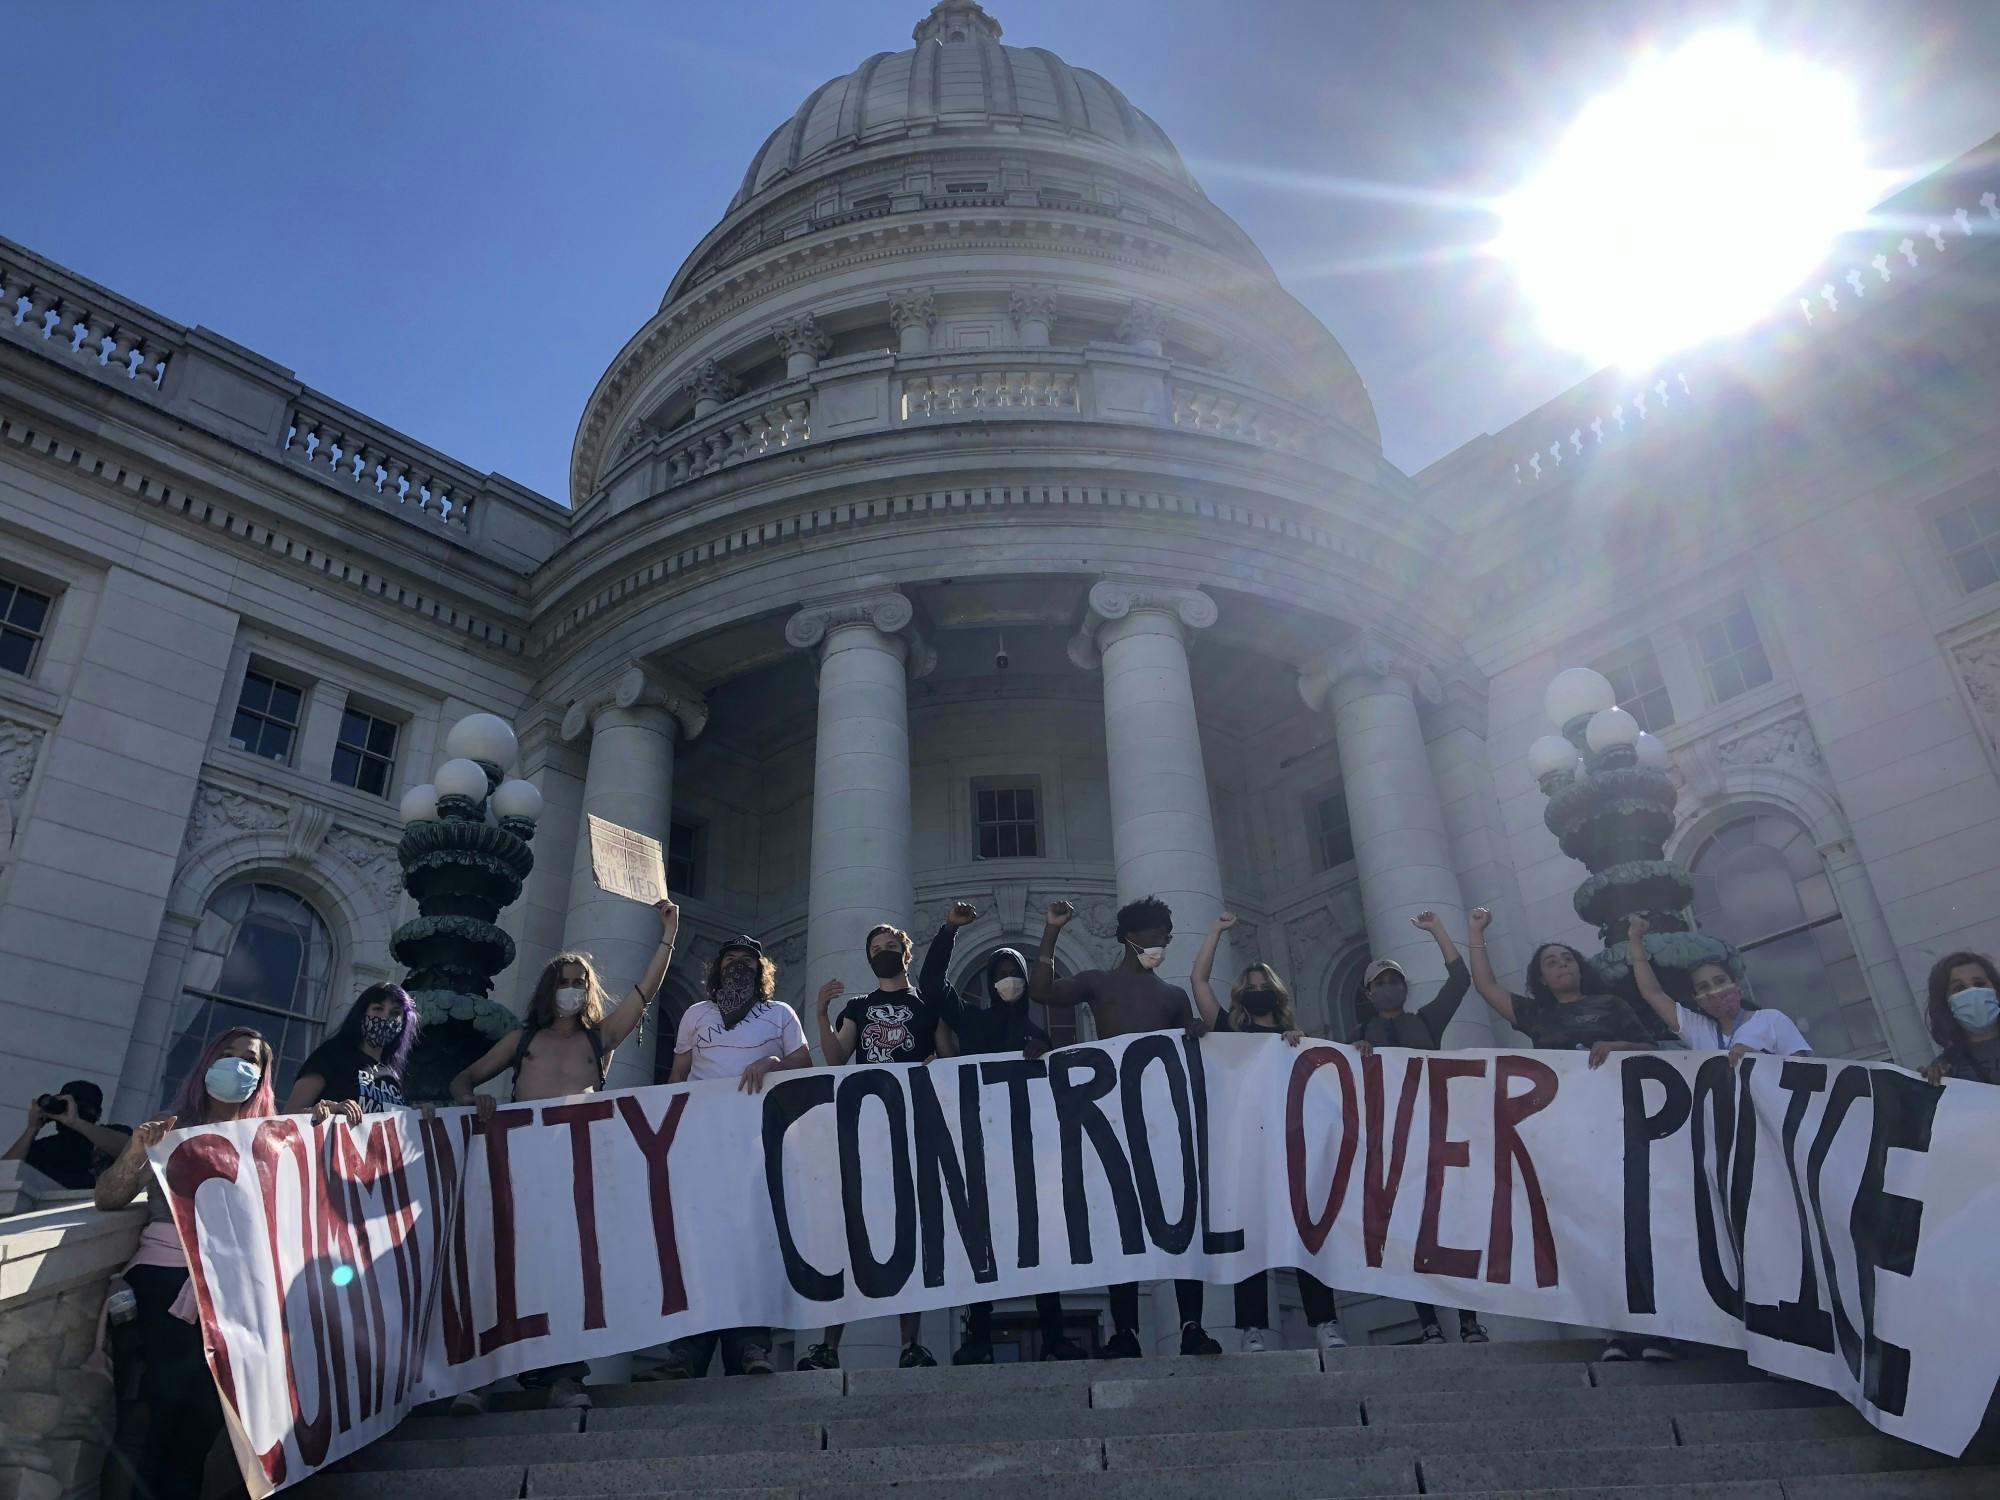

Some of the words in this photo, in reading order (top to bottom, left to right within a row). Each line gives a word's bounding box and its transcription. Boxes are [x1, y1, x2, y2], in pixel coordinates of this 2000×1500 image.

[358, 1070, 404, 1101] BLAC
[166, 1092, 689, 1485] COMMUNITY
[762, 1034, 1245, 1301] CONTROL
[1286, 1046, 1558, 1288] OVER
[1621, 1054, 1946, 1416] POLICE
